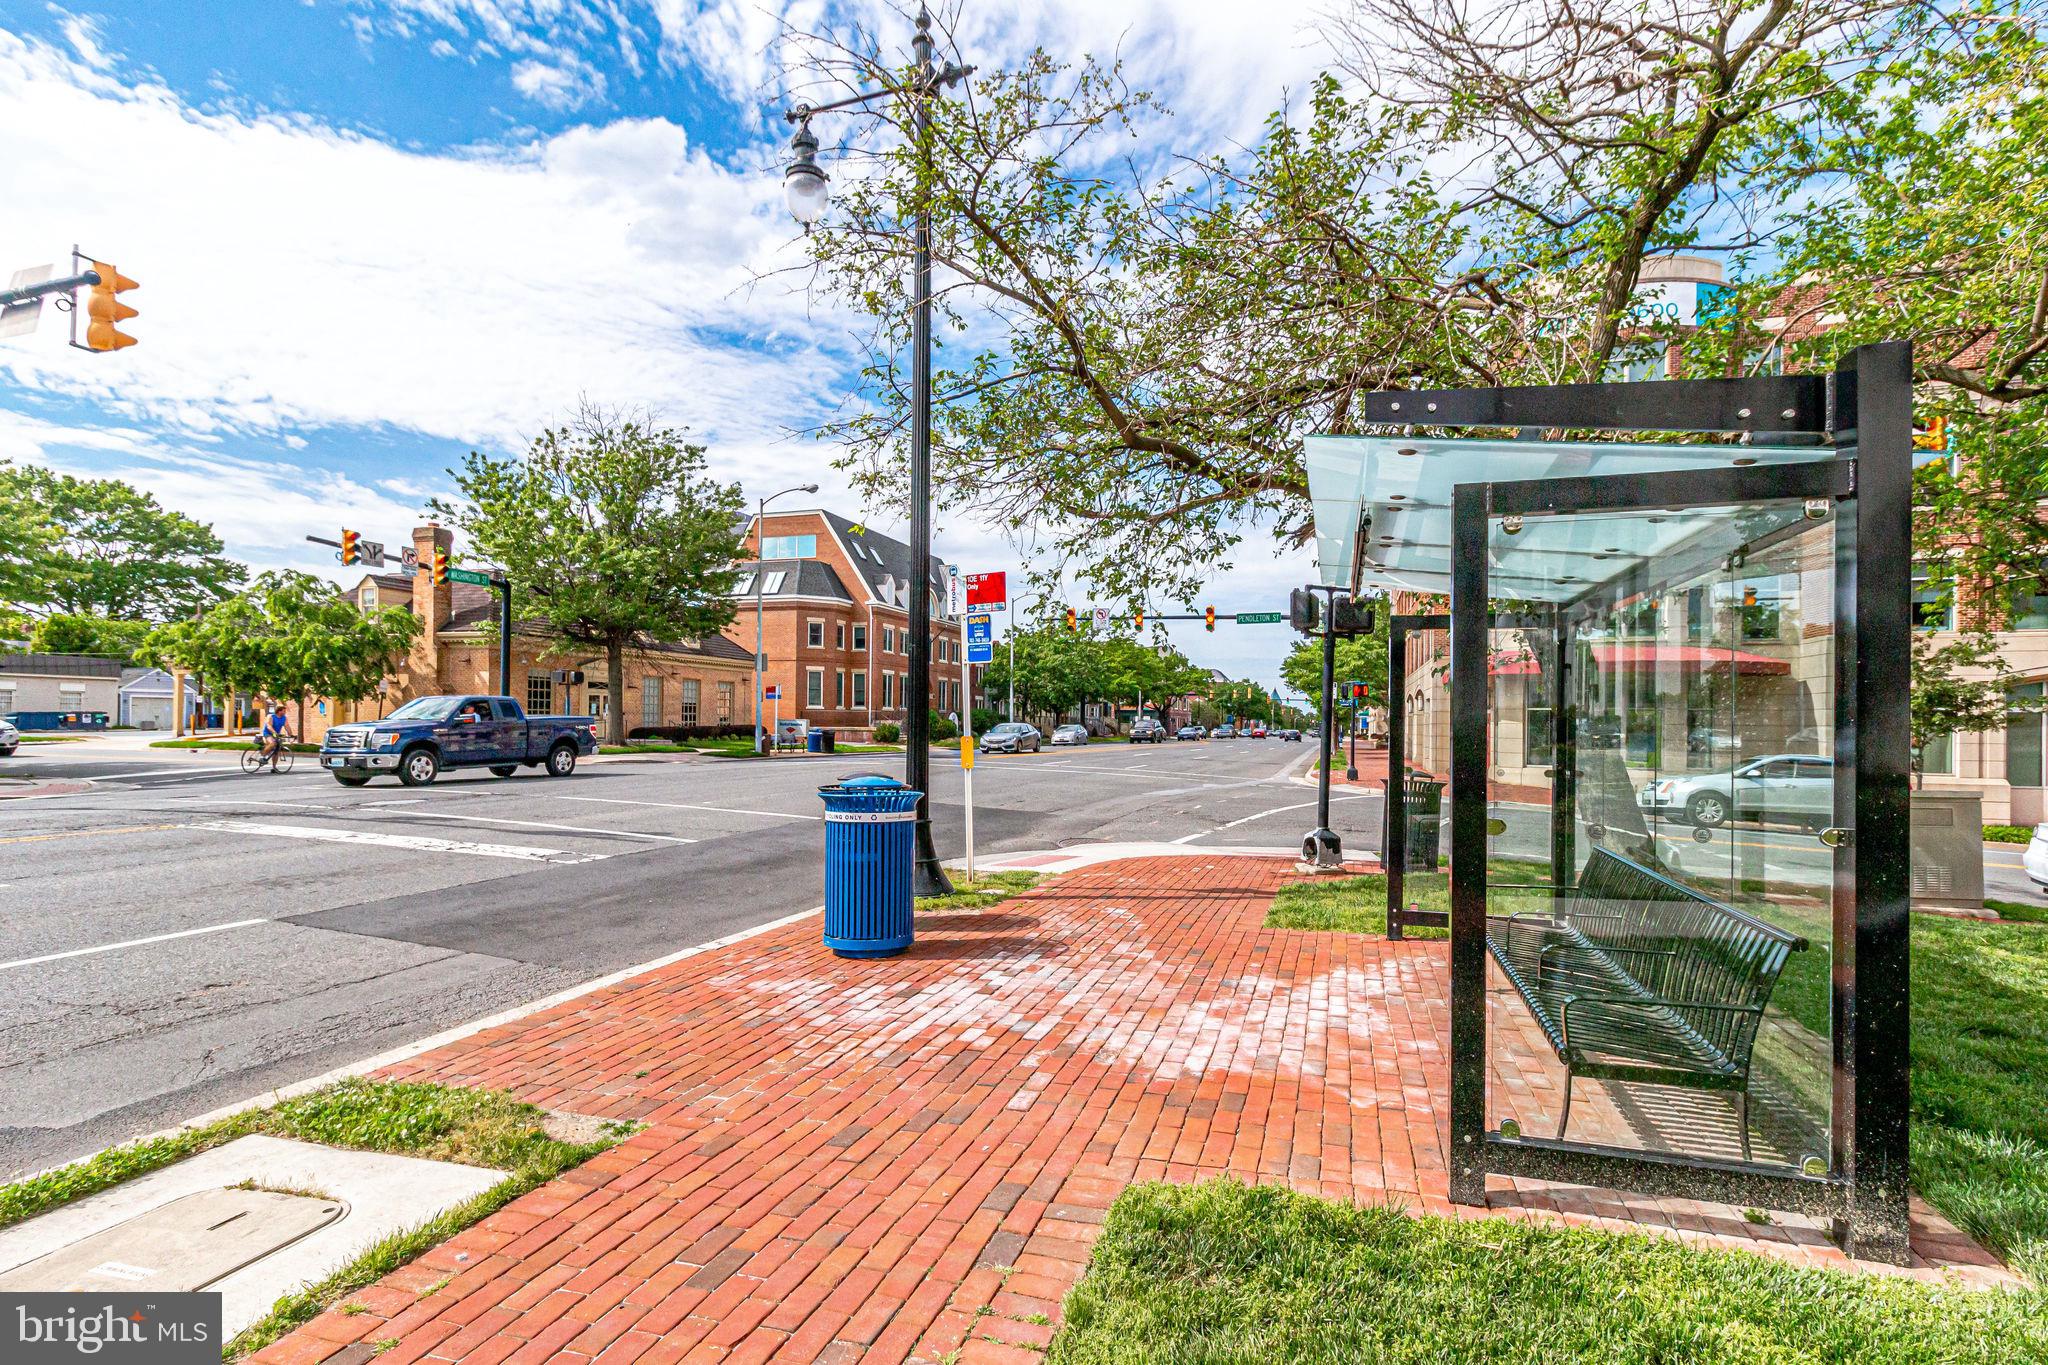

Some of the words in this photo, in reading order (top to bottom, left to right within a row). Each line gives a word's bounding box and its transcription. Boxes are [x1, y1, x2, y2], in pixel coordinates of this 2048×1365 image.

[451, 570, 480, 583] WASHINGTON
[967, 575, 978, 583] 10E
[969, 616, 989, 624] DASH
[1238, 614, 1270, 623] PENDLETON
[1272, 613, 1280, 622] ST
